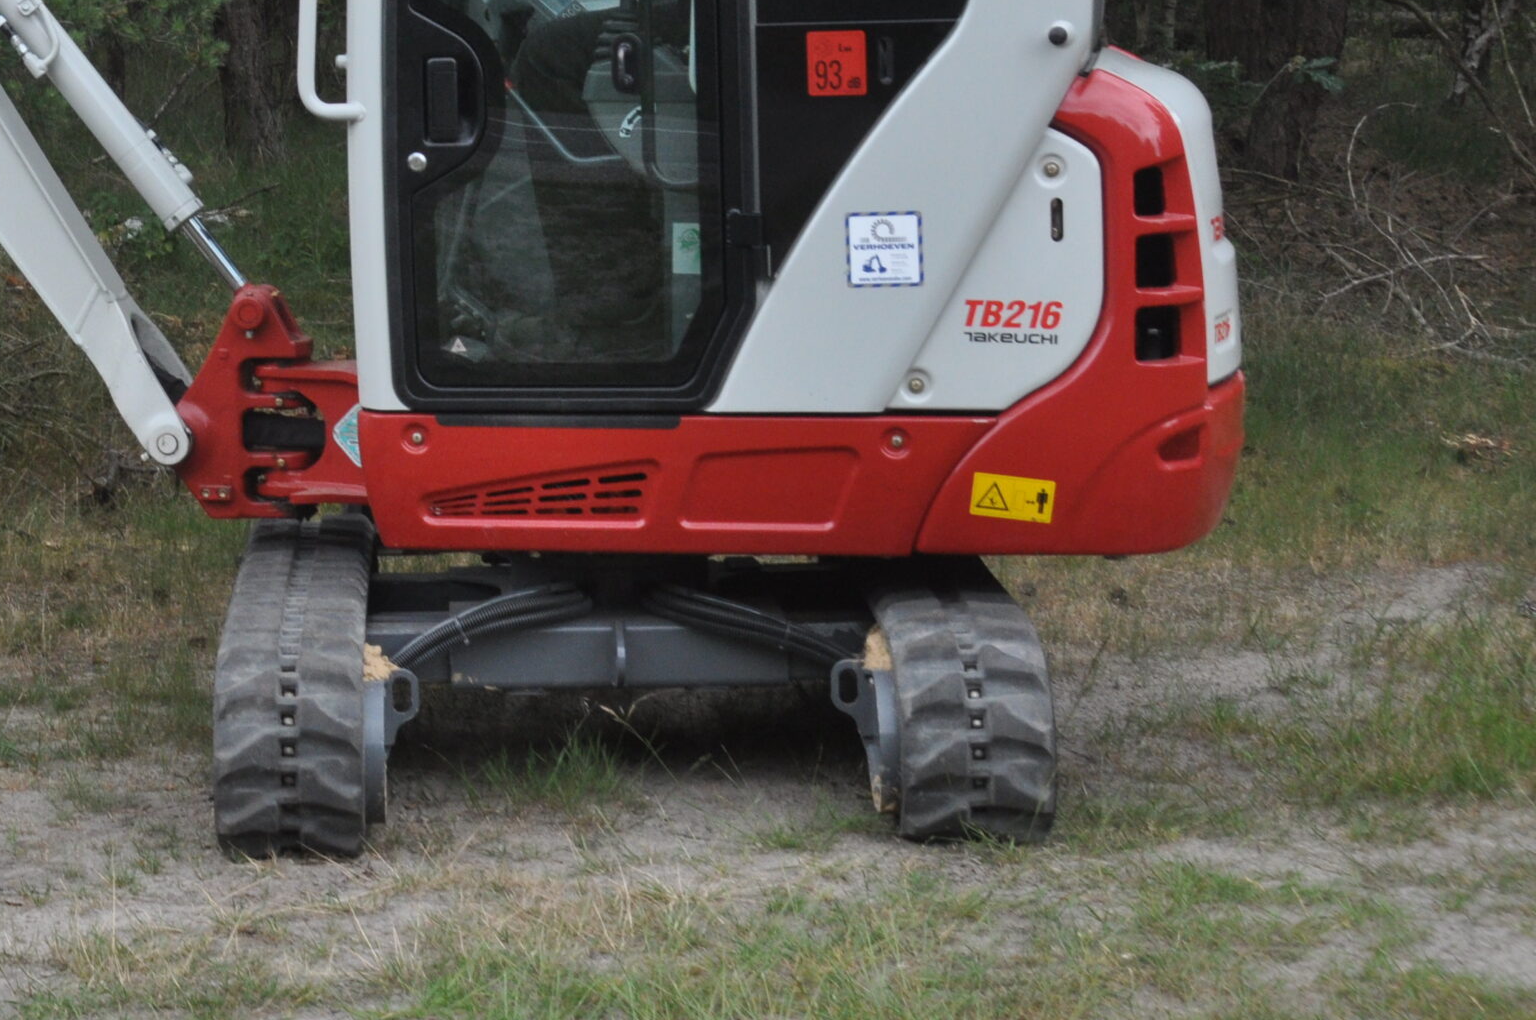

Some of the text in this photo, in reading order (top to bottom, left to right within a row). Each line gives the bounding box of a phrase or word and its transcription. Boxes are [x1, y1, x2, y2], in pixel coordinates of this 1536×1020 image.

[815, 60, 843, 91] 93
[853, 242, 915, 251] VERHOEVEN
[964, 299, 1064, 330] TB216
